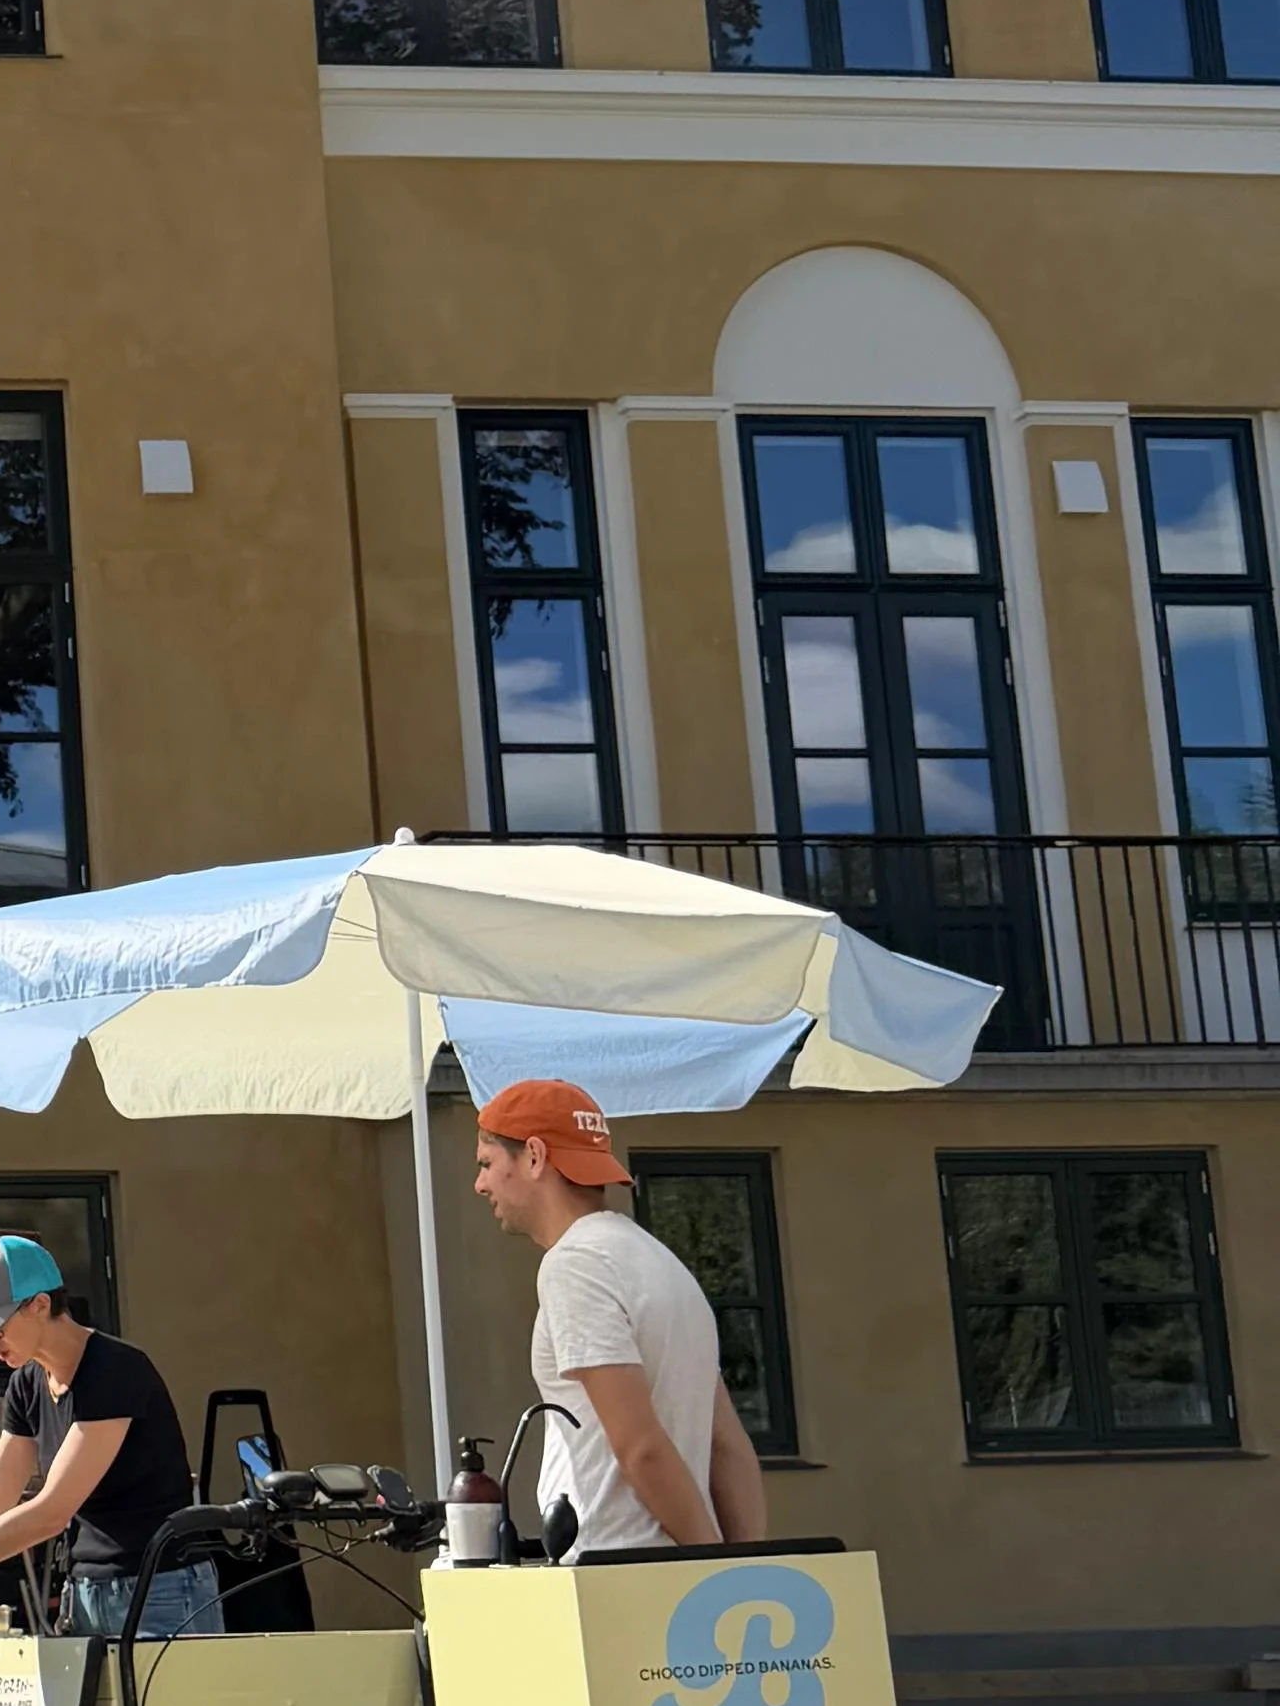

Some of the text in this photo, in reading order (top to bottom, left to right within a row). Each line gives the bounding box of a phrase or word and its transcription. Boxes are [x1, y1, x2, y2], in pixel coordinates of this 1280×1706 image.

[639, 1656, 837, 1681] CHOCO DIPPED BANANAS.
